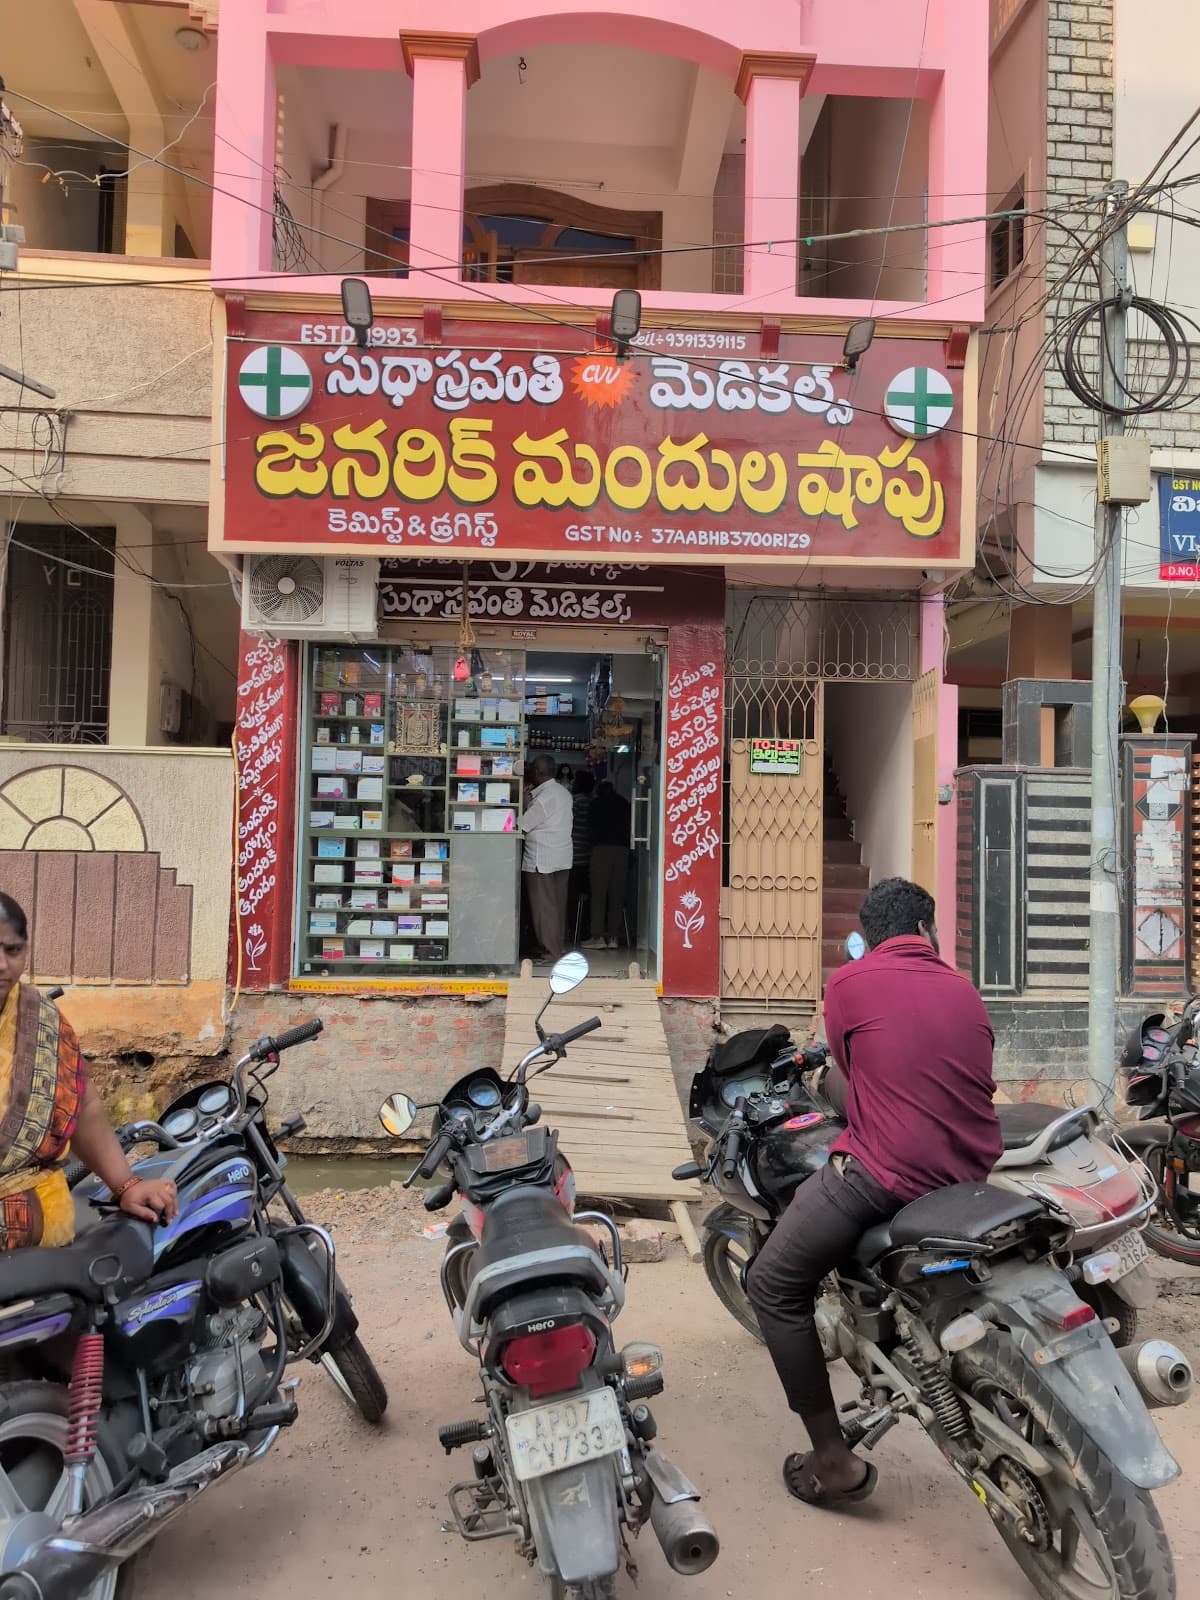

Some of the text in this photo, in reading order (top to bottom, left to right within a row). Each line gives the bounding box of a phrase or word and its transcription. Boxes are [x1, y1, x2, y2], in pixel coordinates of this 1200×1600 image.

[301, 324, 417, 346] ESTD 1993
[649, 357, 854, 425] మెడికల్స్
[255, 417, 945, 537] జనరిక్ మందుల షాపు
[1172, 479, 1190, 490] GST
[327, 507, 499, 547] కెమిస్ట్ & డ్రగిస్ట్
[565, 525, 606, 542] GST
[529, 588, 632, 624] మెడికల్స్
[227, 1166, 249, 1183] Hero
[527, 1319, 555, 1333] Hero
